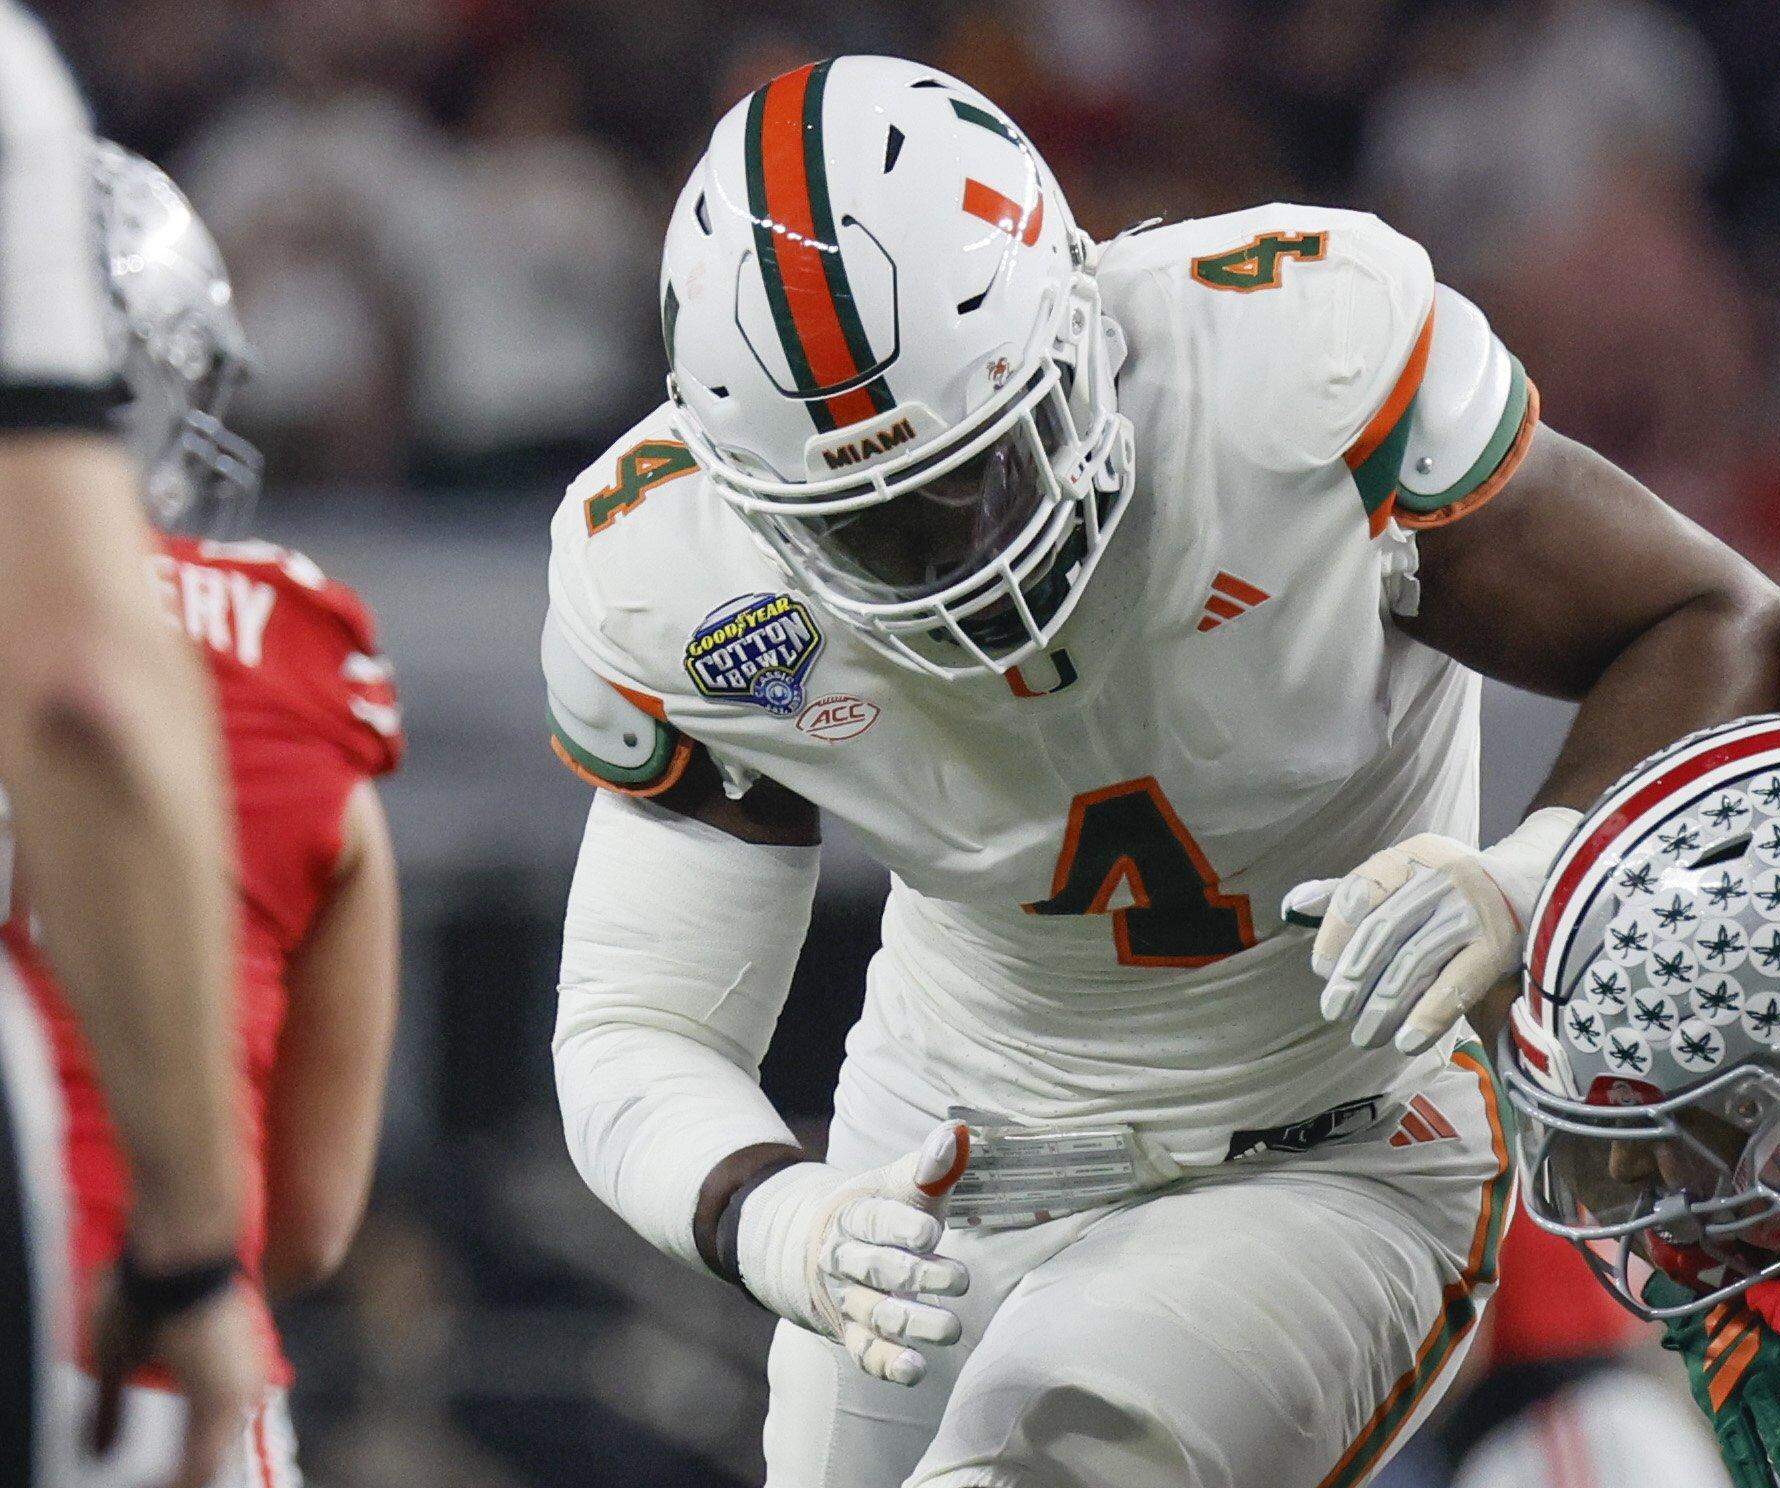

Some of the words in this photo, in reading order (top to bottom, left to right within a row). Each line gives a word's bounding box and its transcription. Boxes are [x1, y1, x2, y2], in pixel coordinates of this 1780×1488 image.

[1191, 230, 1330, 294] 4
[822, 416, 916, 470] MIAMI
[583, 438, 702, 539] 4
[688, 597, 791, 657] GOODYEAR
[694, 611, 812, 690] COTTON
[726, 644, 798, 689] BOWL
[809, 703, 867, 728] ACC
[1018, 774, 1262, 969] 4
